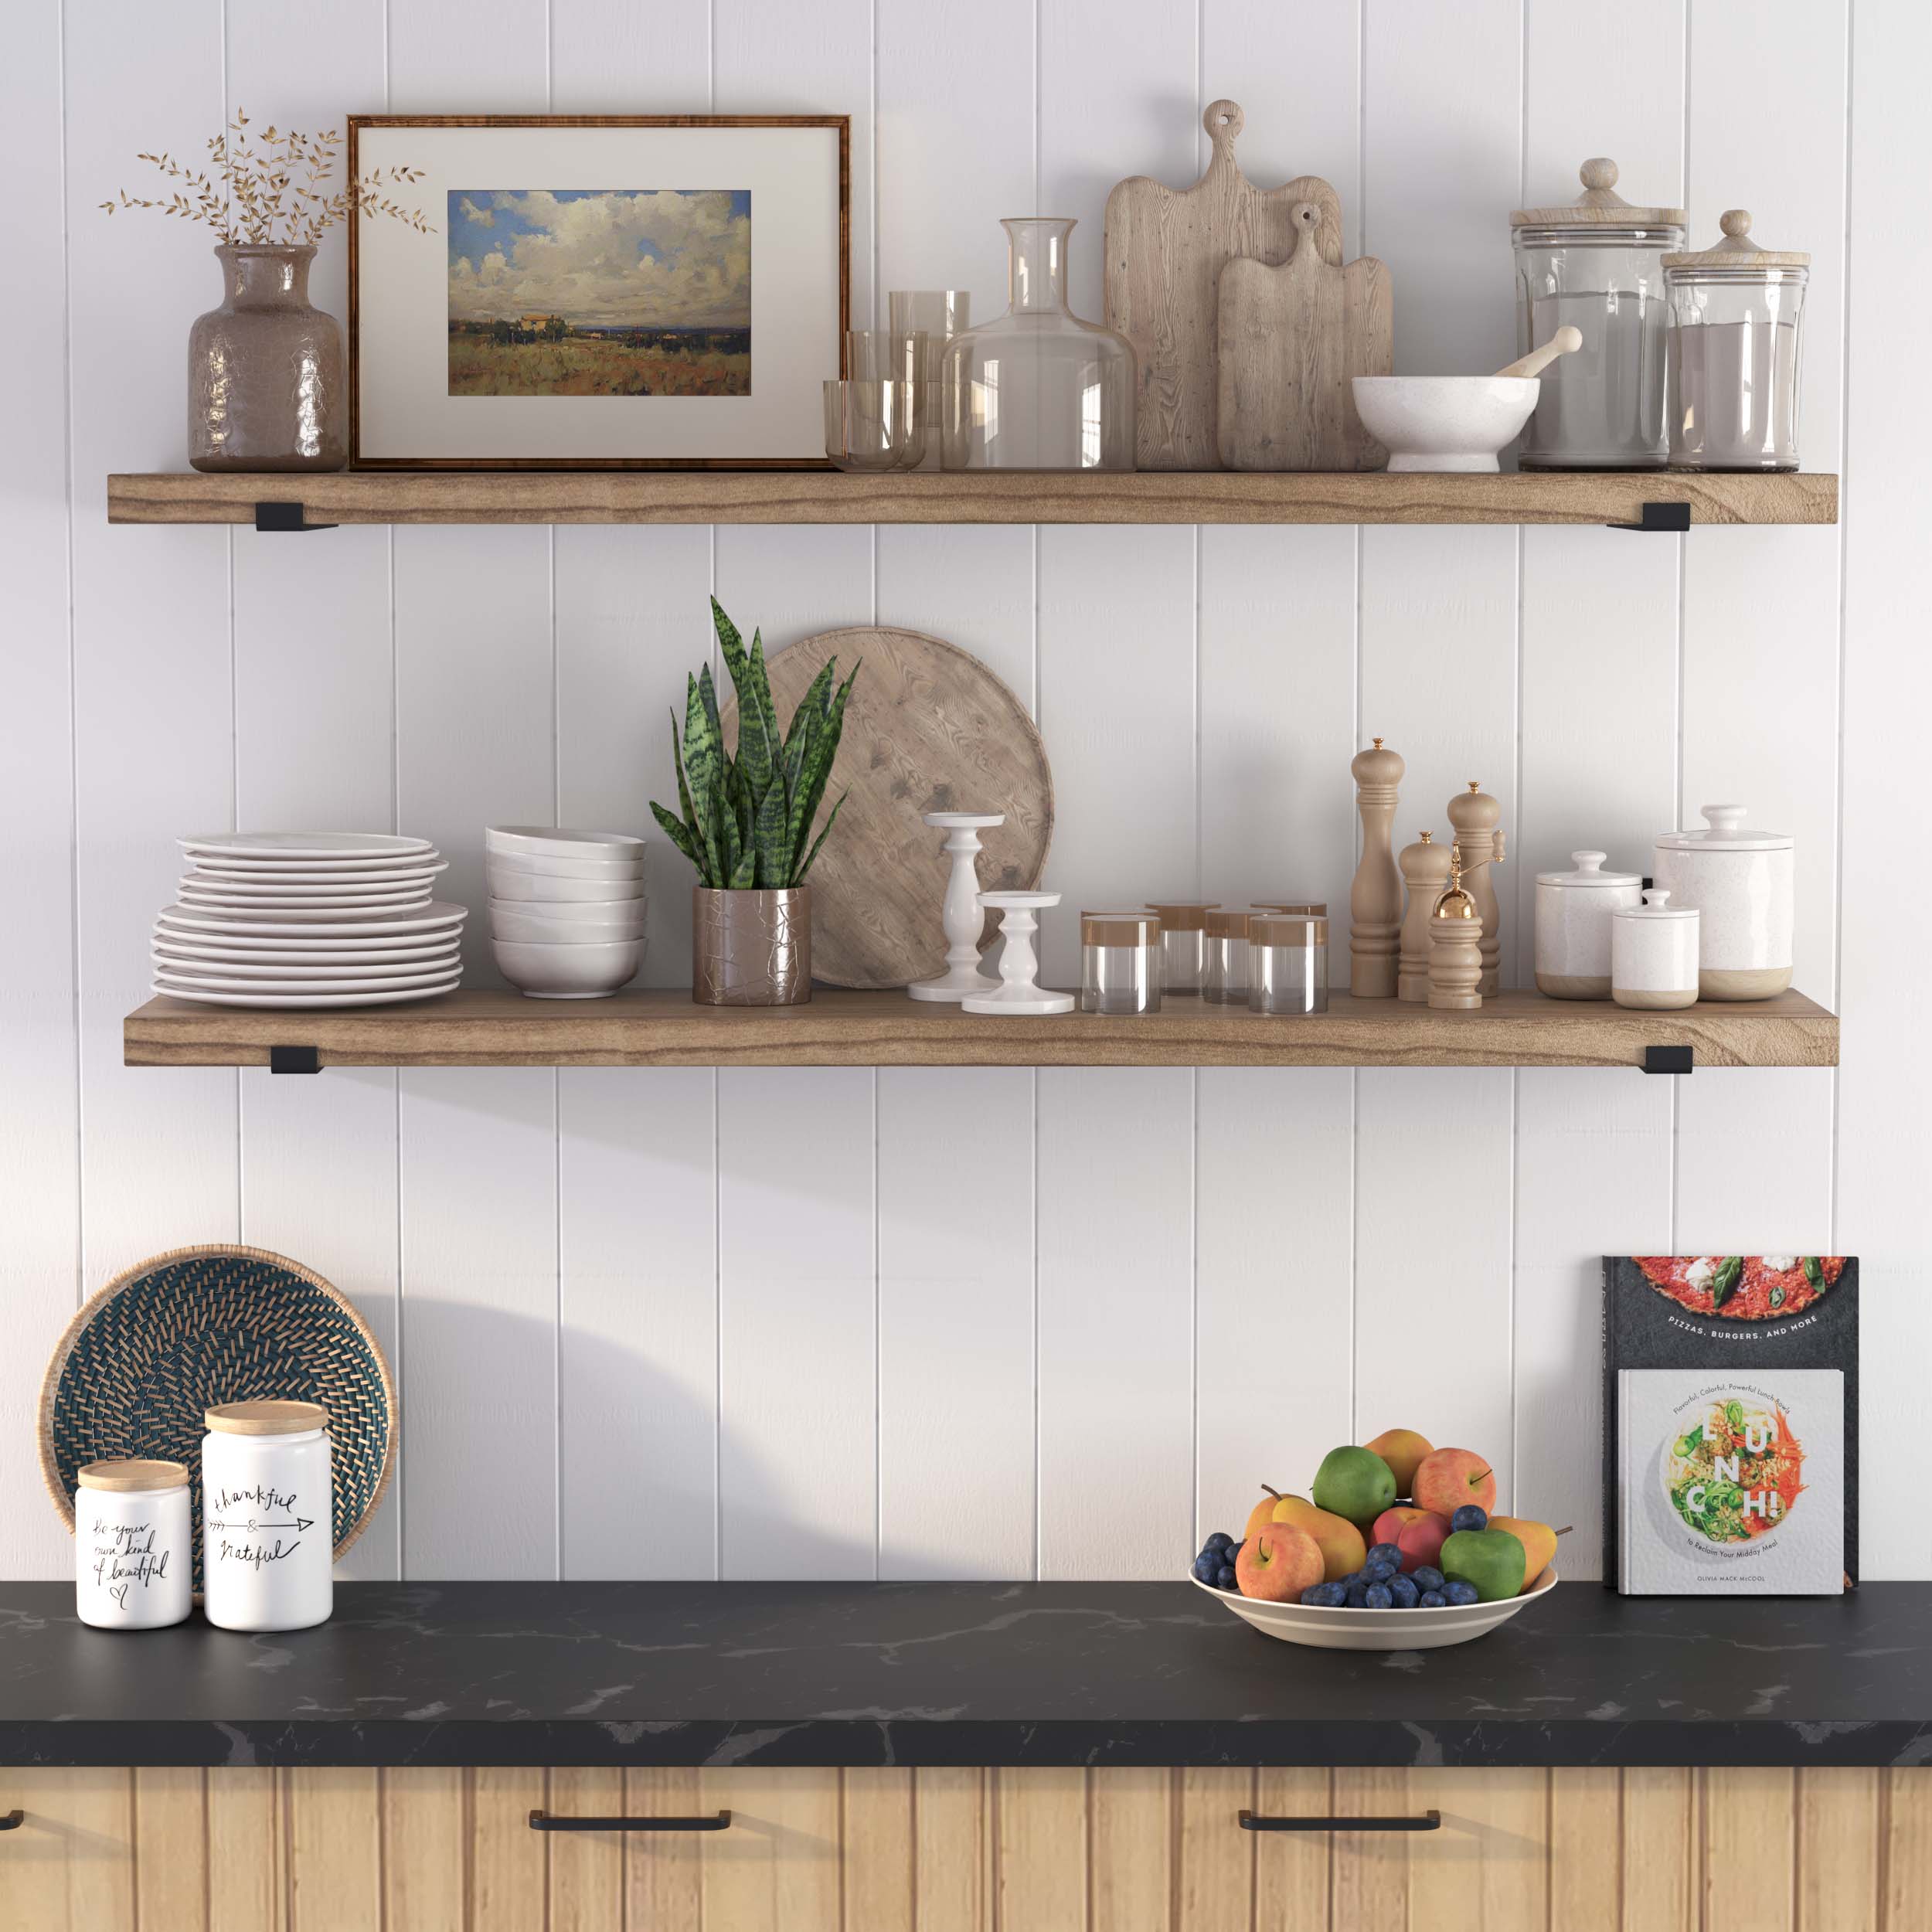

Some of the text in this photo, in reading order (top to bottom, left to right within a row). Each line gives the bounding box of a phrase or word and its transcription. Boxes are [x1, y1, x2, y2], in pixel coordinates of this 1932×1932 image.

[1766, 1328, 1787, 1338] AND
[1790, 1315, 1818, 1332] MORE
[1673, 1383, 1791, 1415] Flavorful, Colorful, Powerful Lunch Bowls
[215, 1484, 297, 1514] thankful
[94, 1529, 155, 1558] own kind
[111, 1522, 150, 1546] your
[1687, 1537, 1693, 1546] to
[1695, 1542, 1718, 1556] Reclaim
[1736, 1549, 1760, 1559] Midday
[1762, 1539, 1778, 1553] Meal
[94, 1550, 170, 1588] of beautiful
